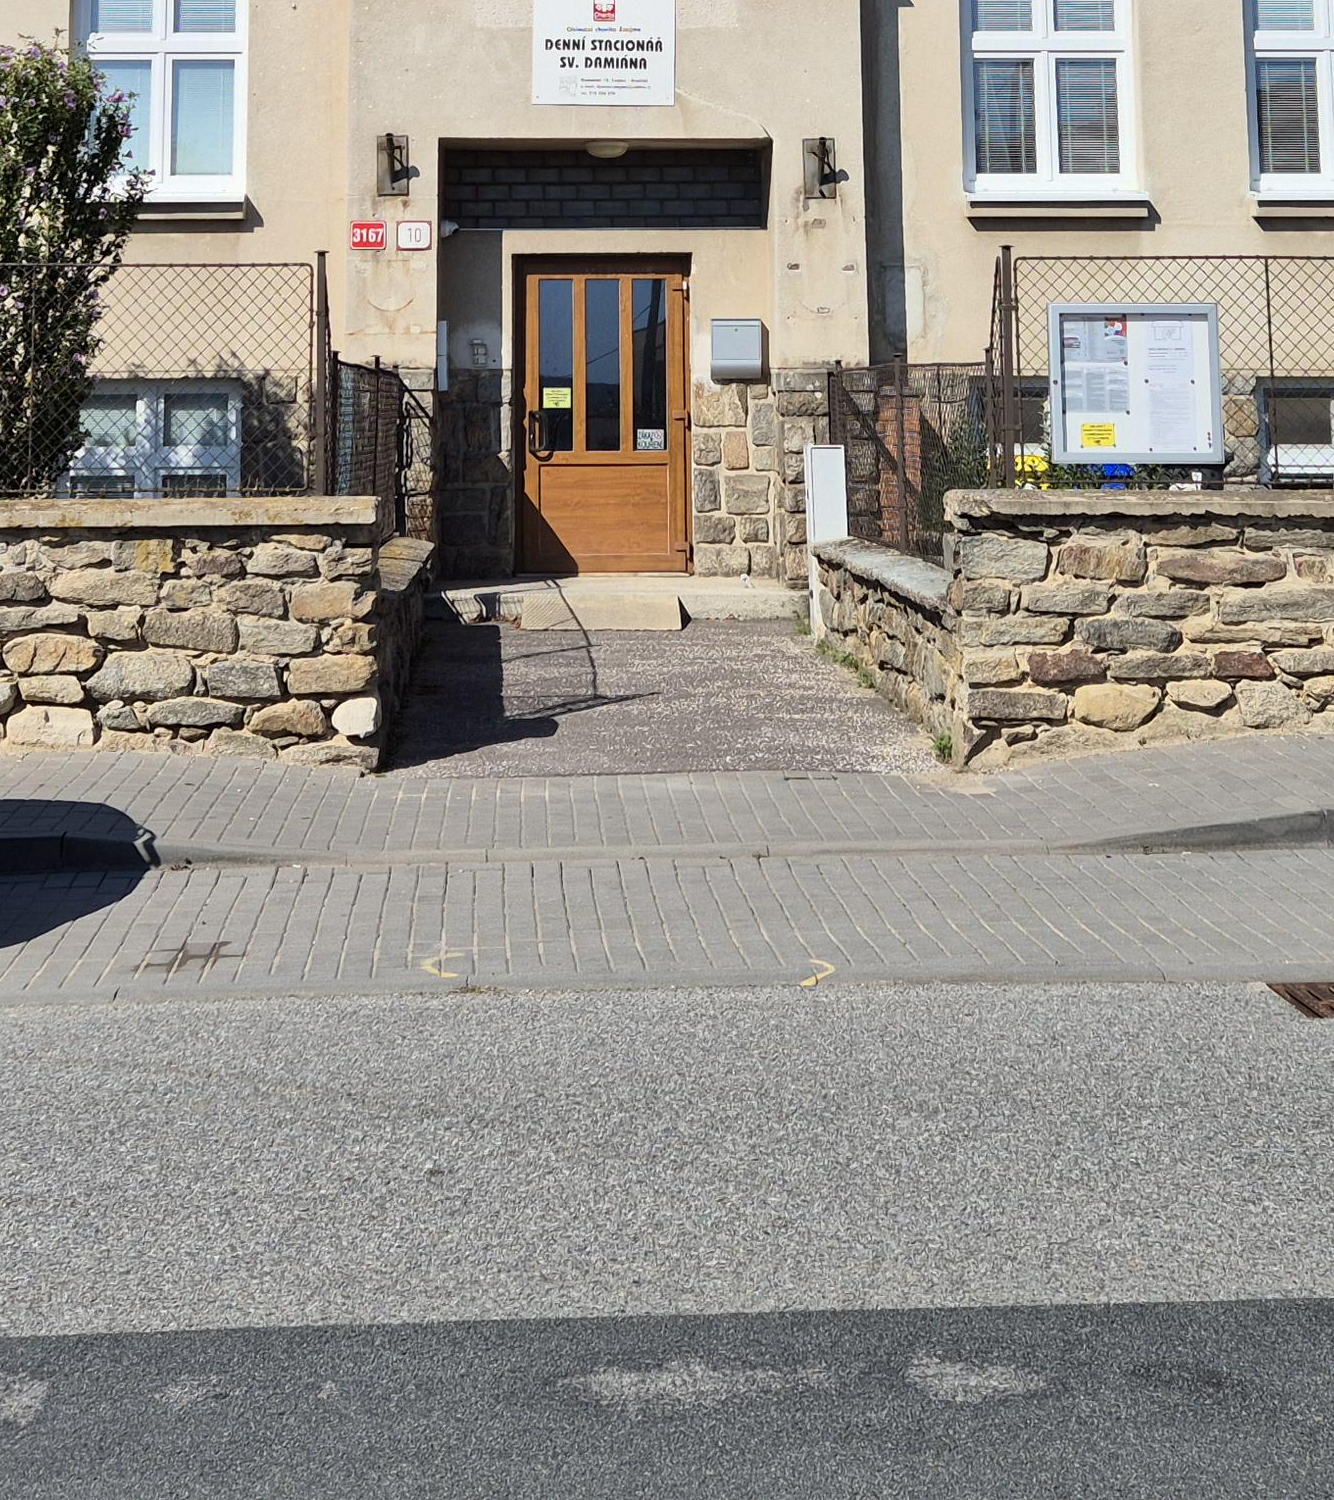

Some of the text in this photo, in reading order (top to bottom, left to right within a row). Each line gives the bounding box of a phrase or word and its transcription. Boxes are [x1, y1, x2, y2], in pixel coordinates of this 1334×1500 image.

[545, 36, 663, 52] DENNÍ STACIONÁŘ
[559, 54, 647, 70] SV. DAMIÁNA
[353, 228, 384, 243] 3167
[408, 228, 422, 243] 10
